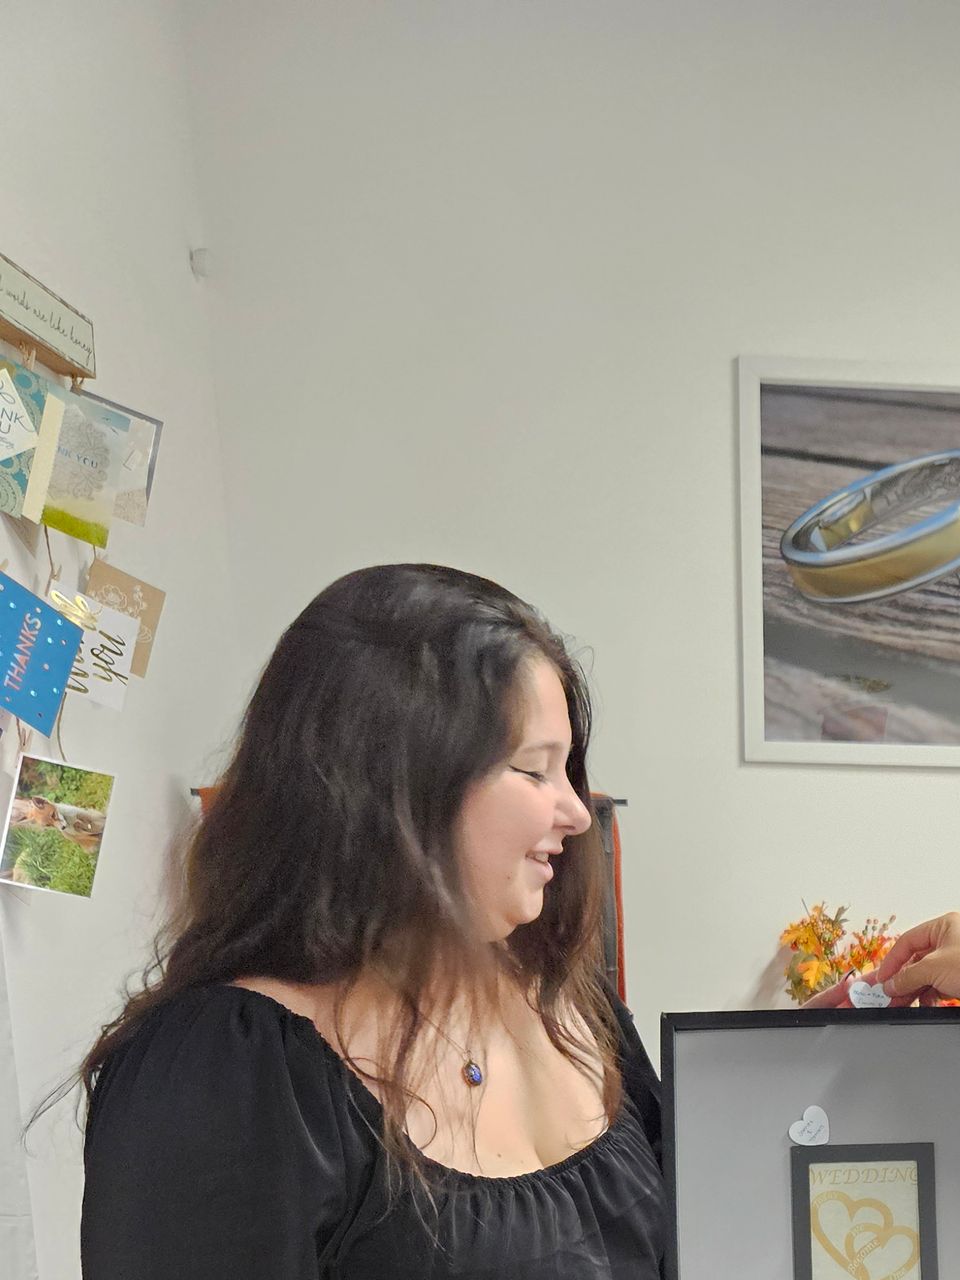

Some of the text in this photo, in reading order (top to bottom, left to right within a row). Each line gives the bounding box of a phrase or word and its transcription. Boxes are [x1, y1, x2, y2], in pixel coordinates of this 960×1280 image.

[33, 308, 47, 322] are
[50, 311, 68, 338] like
[76, 453, 98, 469] YOU
[3, 613, 42, 692] THANKS
[90, 630, 129, 687] you
[811, 1166, 917, 1185] WEDDING
[848, 1238, 881, 1274] Become
